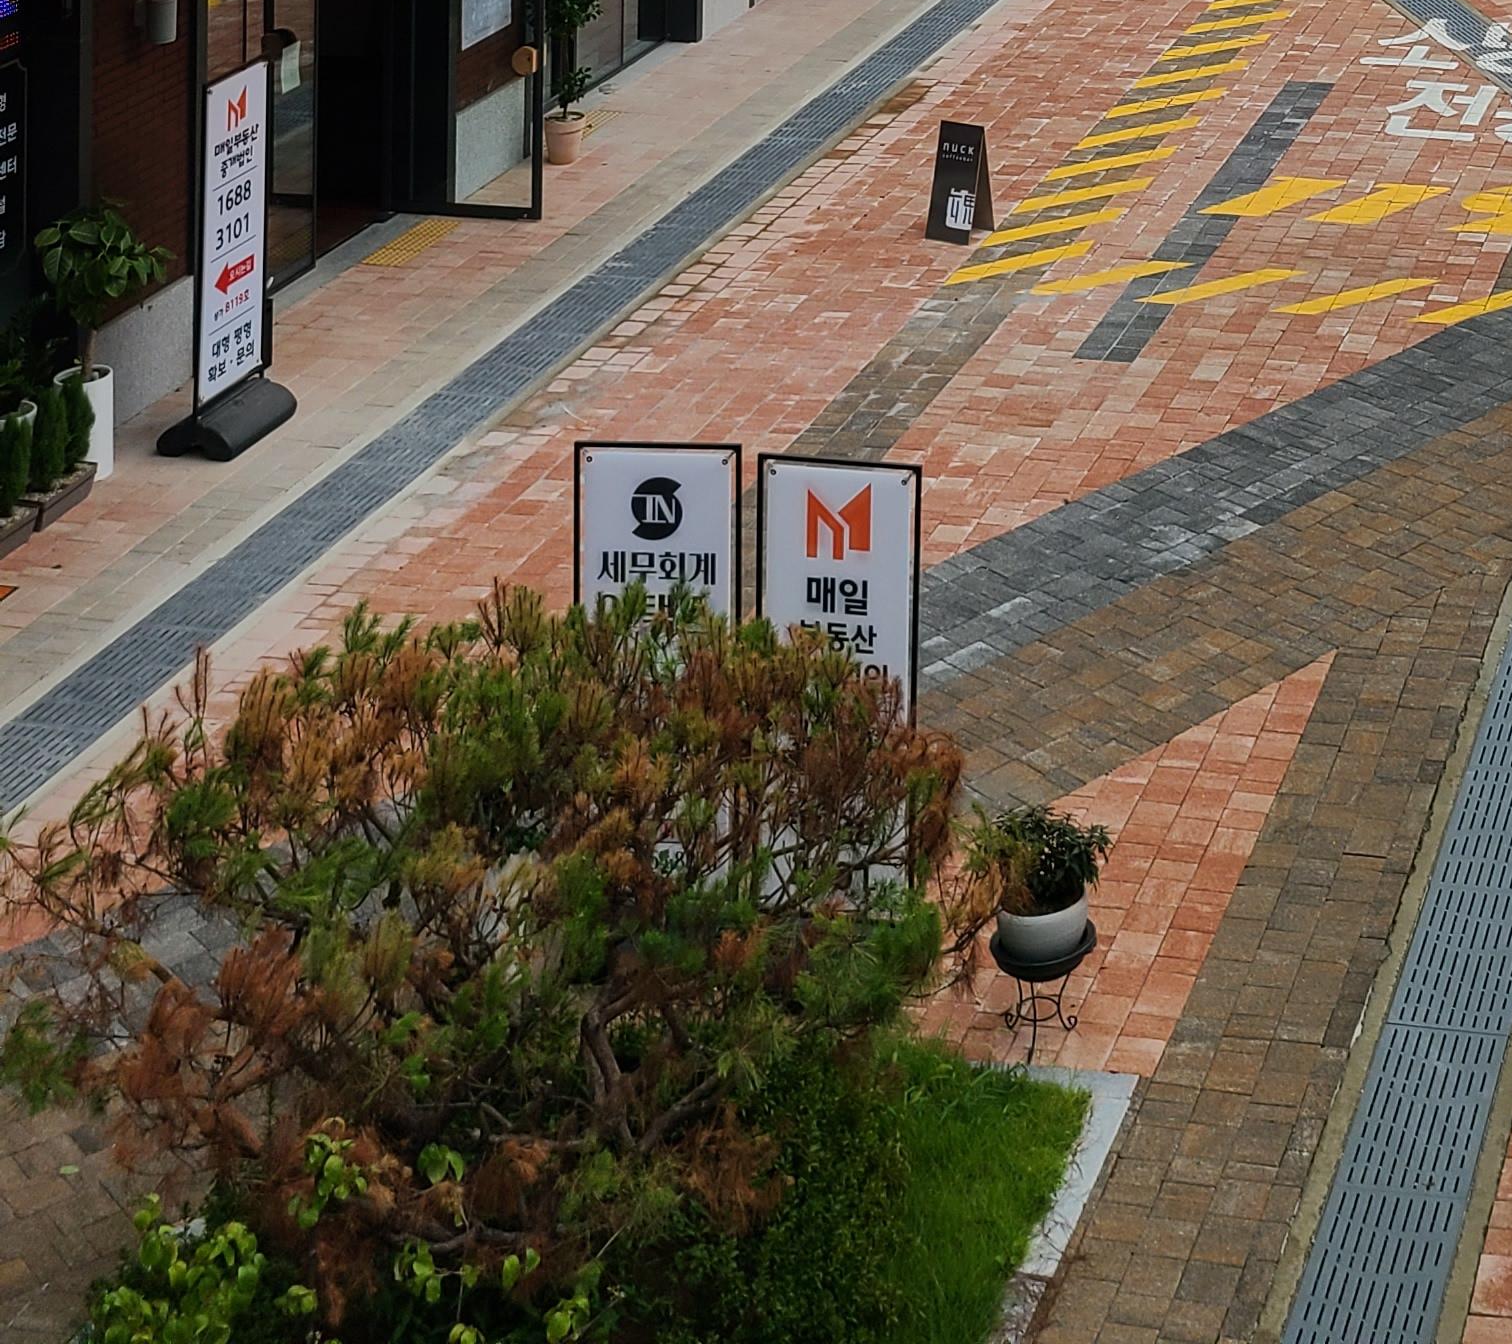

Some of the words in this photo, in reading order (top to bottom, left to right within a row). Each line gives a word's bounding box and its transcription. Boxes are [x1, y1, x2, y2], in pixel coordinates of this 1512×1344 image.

[214, 124, 259, 157] 매일부동산
[217, 179, 251, 216] 1688
[216, 213, 249, 250] 3101
[236, 339, 255, 365] 문의
[597, 551, 716, 585] 세무회계
[806, 576, 868, 617] 매일
